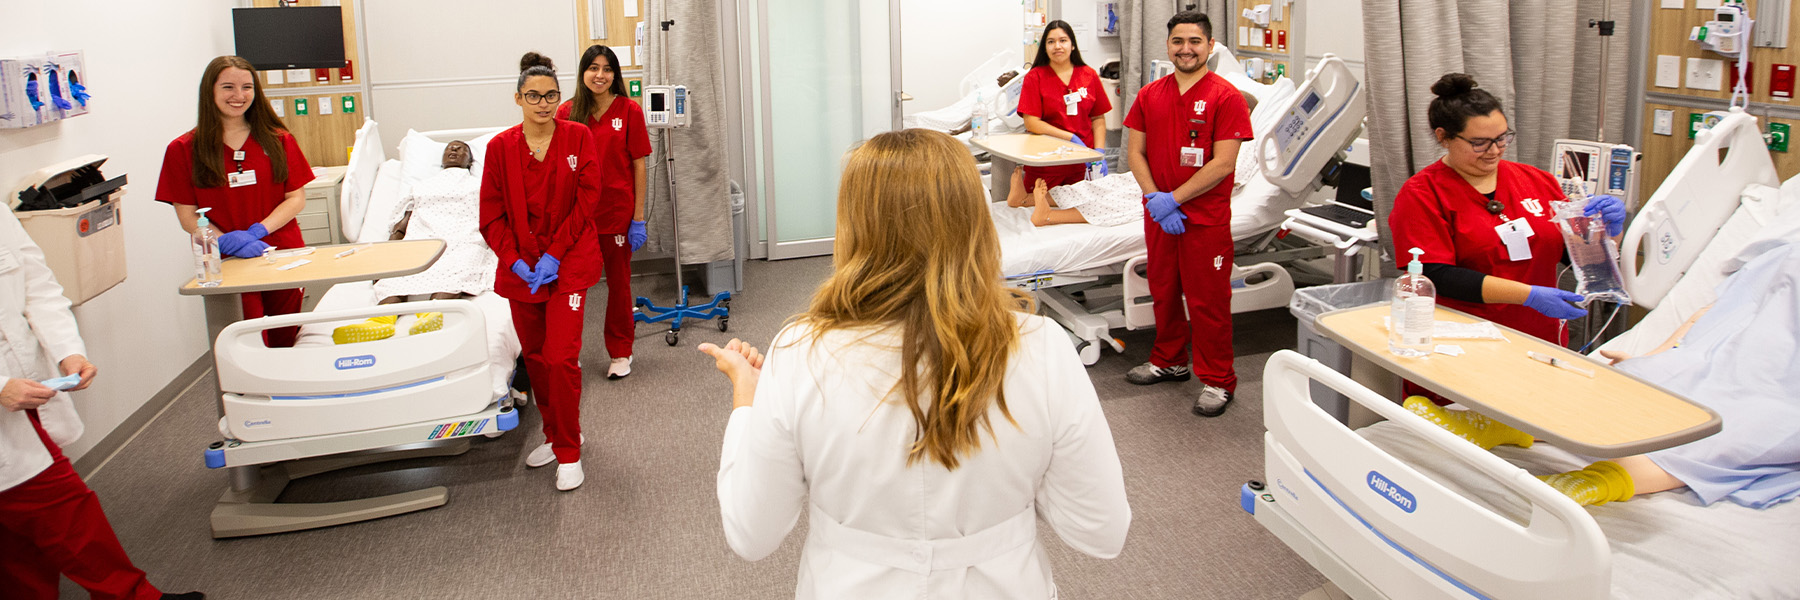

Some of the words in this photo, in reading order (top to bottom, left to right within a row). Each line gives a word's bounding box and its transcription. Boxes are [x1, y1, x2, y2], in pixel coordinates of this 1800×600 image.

[1193, 99, 1207, 115] IU
[611, 117, 623, 131] IU
[566, 154, 578, 171] IU
[1520, 198, 1544, 217] IU
[614, 234, 625, 247] IU
[1213, 255, 1224, 270] IU
[568, 293, 582, 311] IU
[338, 358, 373, 368] Hill-Rom
[1370, 474, 1413, 509] Hill-Rom
